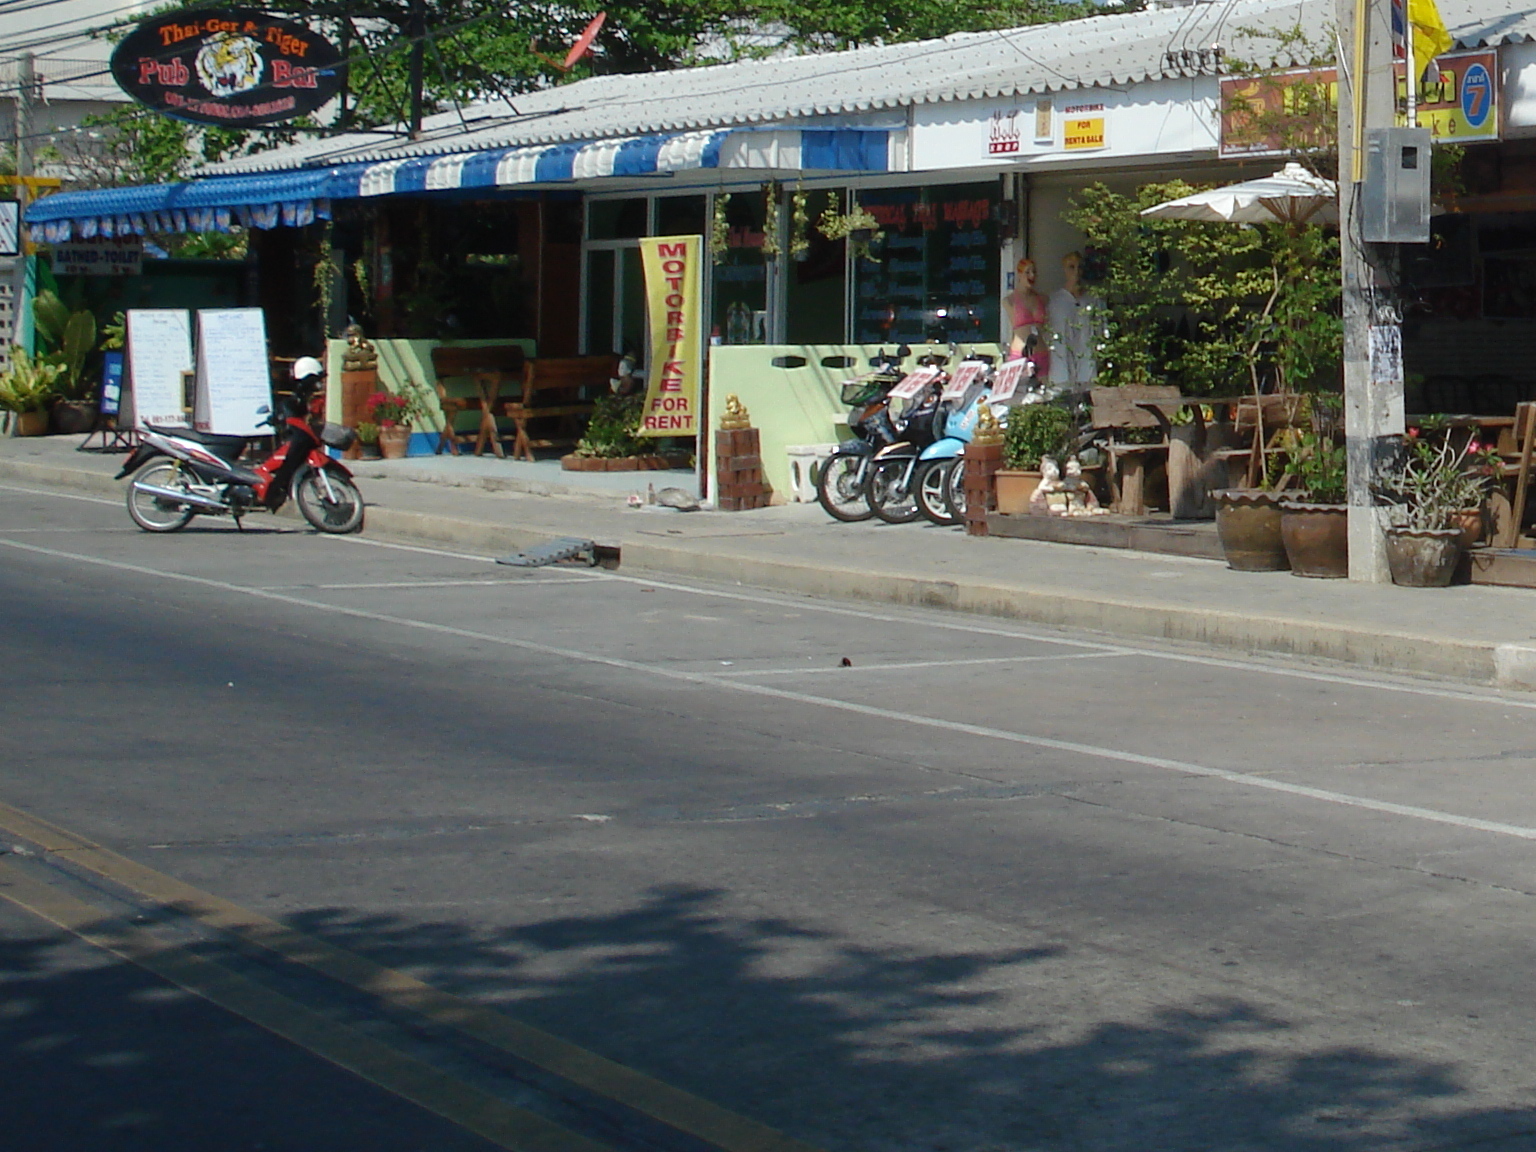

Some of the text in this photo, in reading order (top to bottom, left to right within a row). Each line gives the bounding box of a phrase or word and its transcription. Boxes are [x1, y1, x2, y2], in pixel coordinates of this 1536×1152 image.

[265, 26, 310, 58] Tiger
[138, 56, 318, 89] Pub Bar
[1466, 85, 1487, 117] 7
[657, 242, 688, 393] MOTORBIKE
[651, 397, 689, 412] FOR
[644, 414, 694, 430] RENT
